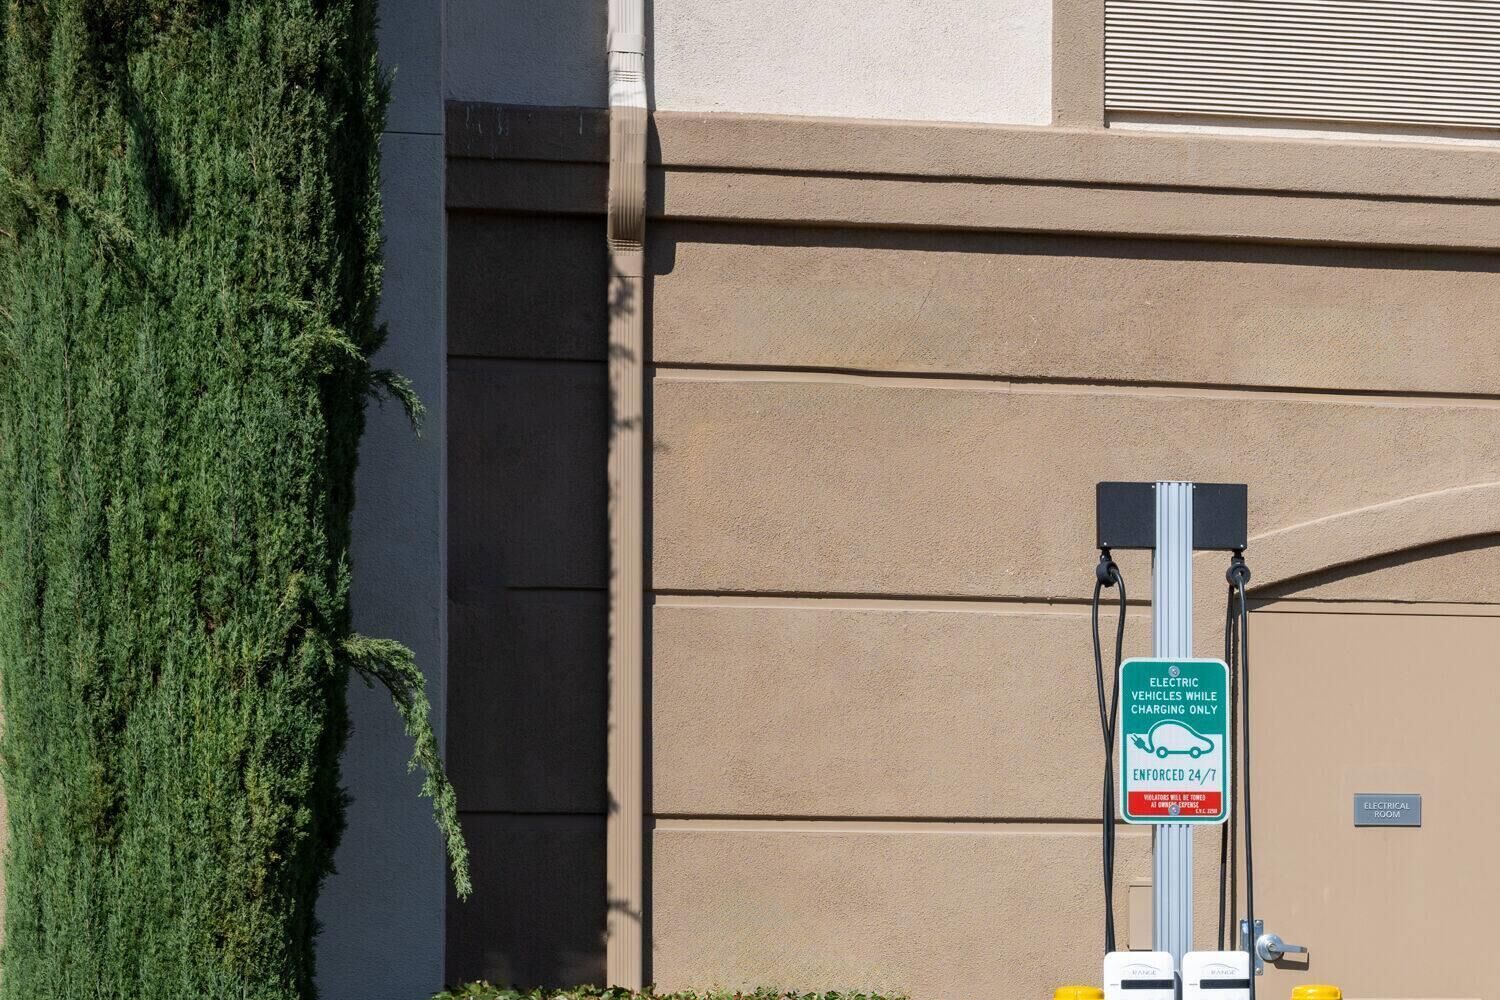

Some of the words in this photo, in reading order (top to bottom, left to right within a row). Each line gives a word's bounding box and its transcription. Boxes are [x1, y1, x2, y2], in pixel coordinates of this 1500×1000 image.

[1150, 677, 1199, 687] ELECTRIC
[1131, 691, 1182, 701] VEHICLES
[1186, 691, 1217, 701] WHILE
[1131, 704, 1185, 714] CHARGING
[1189, 705, 1218, 715] ONLY
[1133, 768, 1184, 781] ENFORCED
[1188, 767, 1216, 785] 24/7
[1178, 801, 1200, 809] EXPENSE
[1364, 802, 1410, 810] ELECTRICAL
[1374, 810, 1400, 818] ROOM
